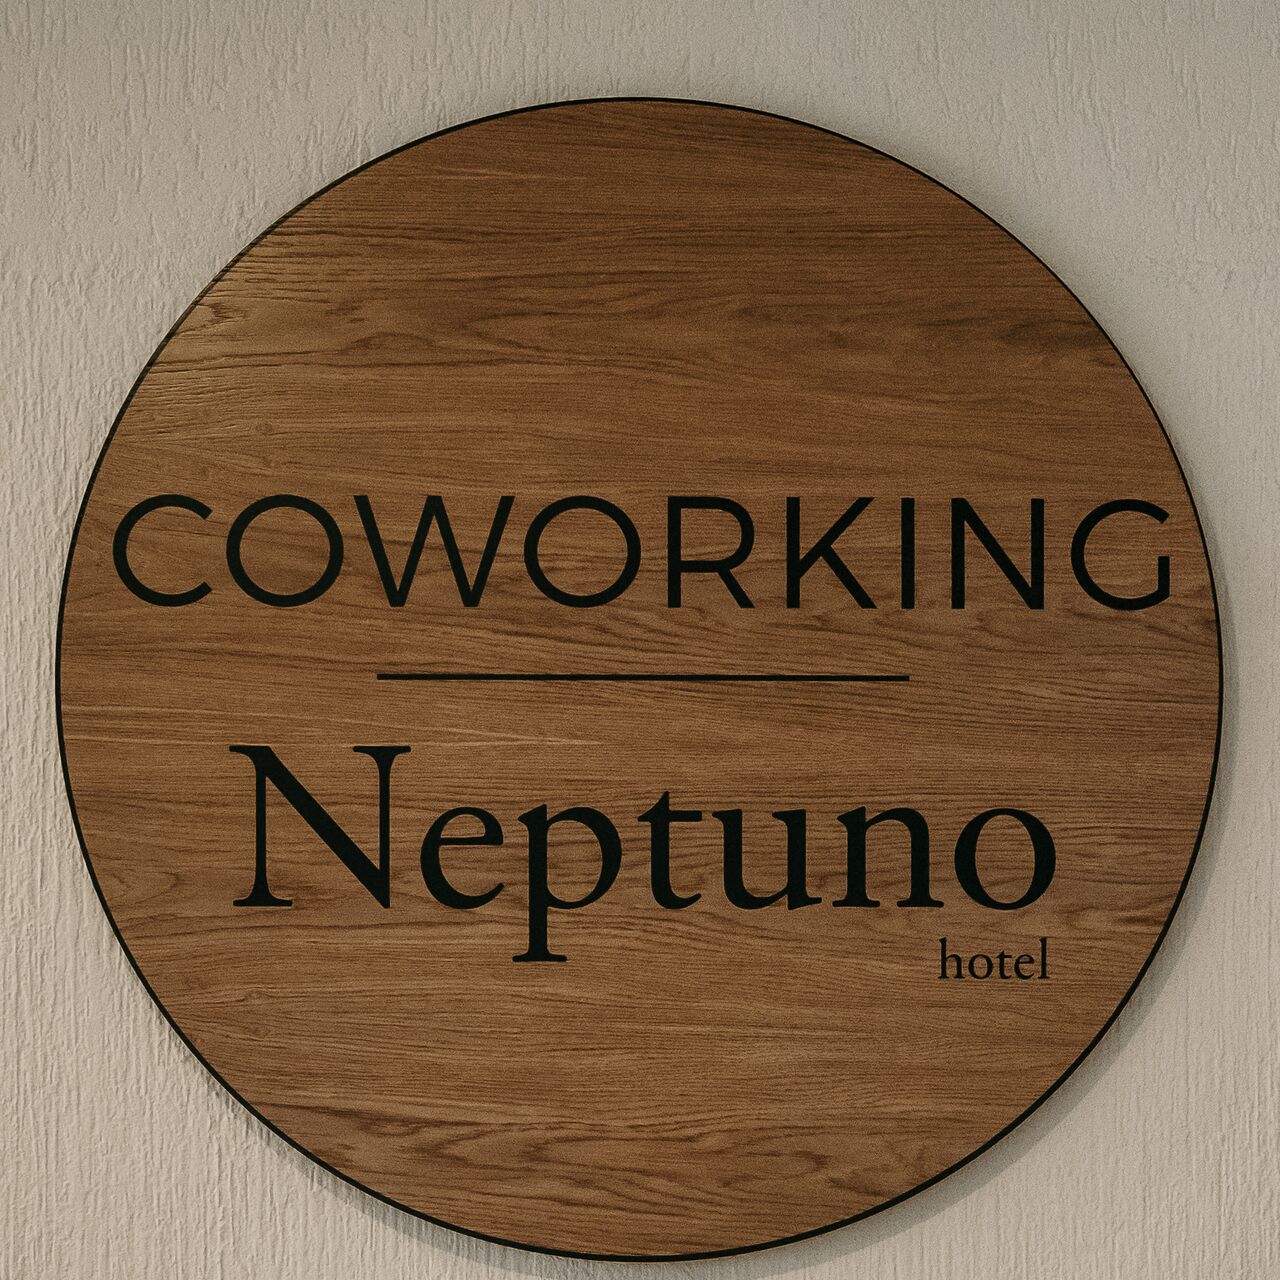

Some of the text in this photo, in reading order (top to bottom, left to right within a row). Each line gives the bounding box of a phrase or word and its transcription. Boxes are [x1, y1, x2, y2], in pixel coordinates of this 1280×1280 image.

[112, 494, 1170, 612] COWORKING
[228, 745, 1057, 963] Neptuno
[937, 937, 1050, 980] hotel
